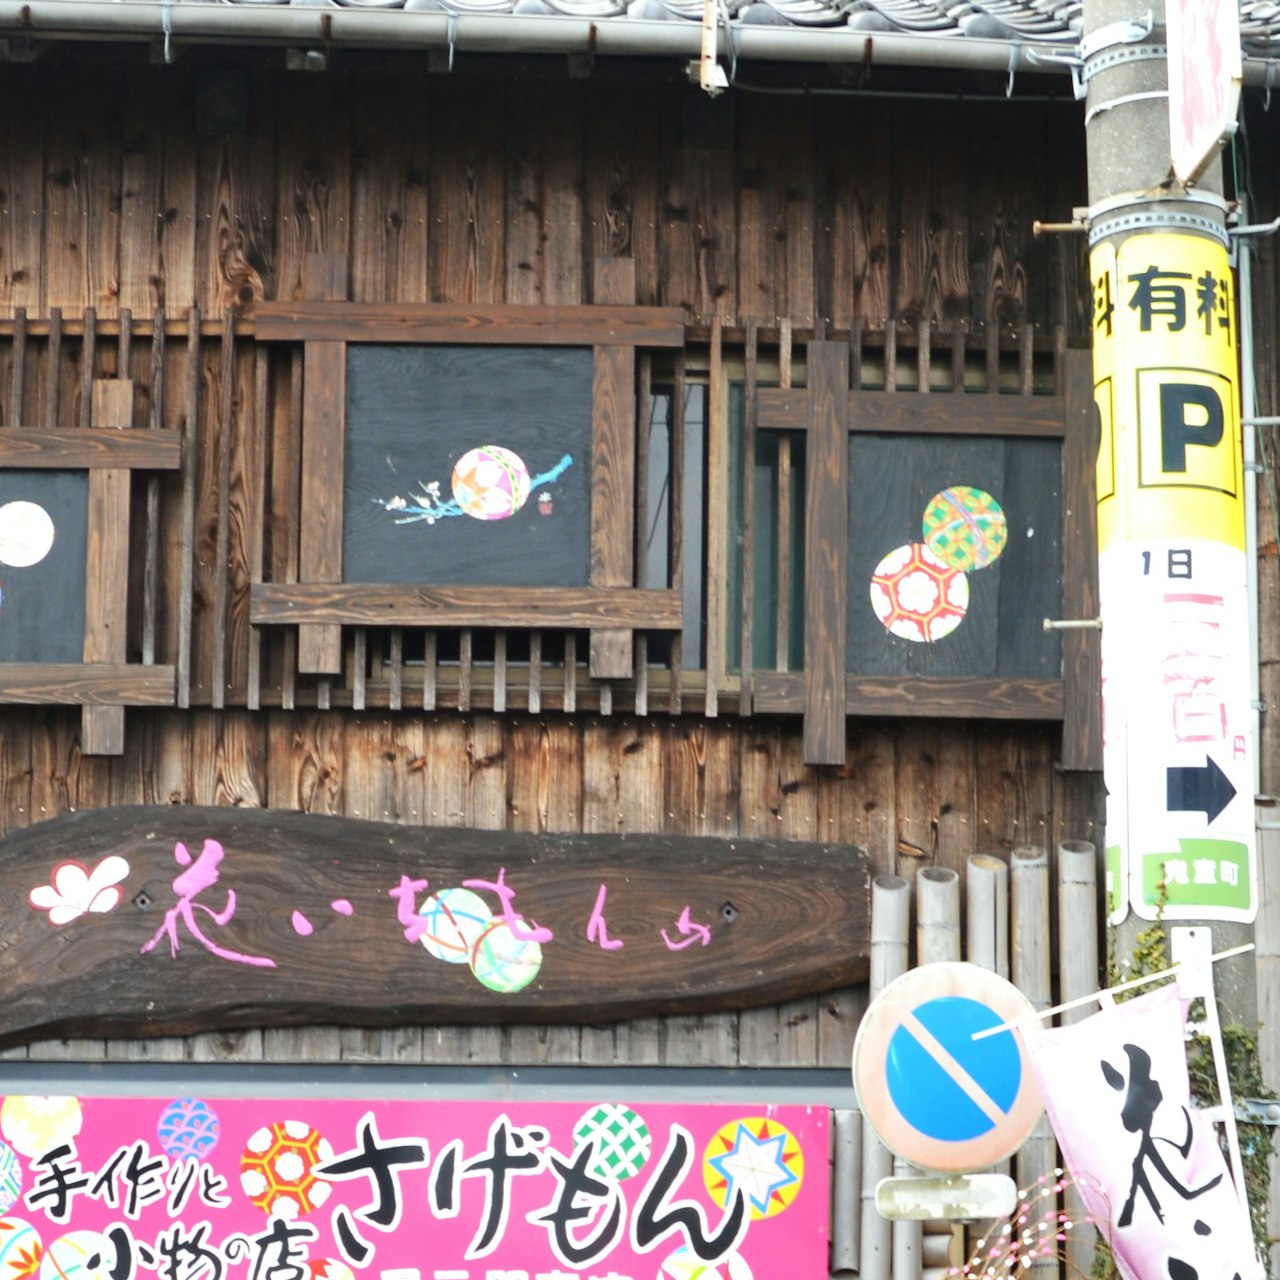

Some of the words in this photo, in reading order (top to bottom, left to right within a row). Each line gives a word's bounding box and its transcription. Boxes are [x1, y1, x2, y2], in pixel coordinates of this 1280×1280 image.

[1128, 266, 1232, 348] 有料
[1160, 383, 1224, 474] P
[1141, 549, 1193, 580] 1日
[26, 1146, 229, 1219] 手作りと
[319, 1113, 747, 1263] さげもん
